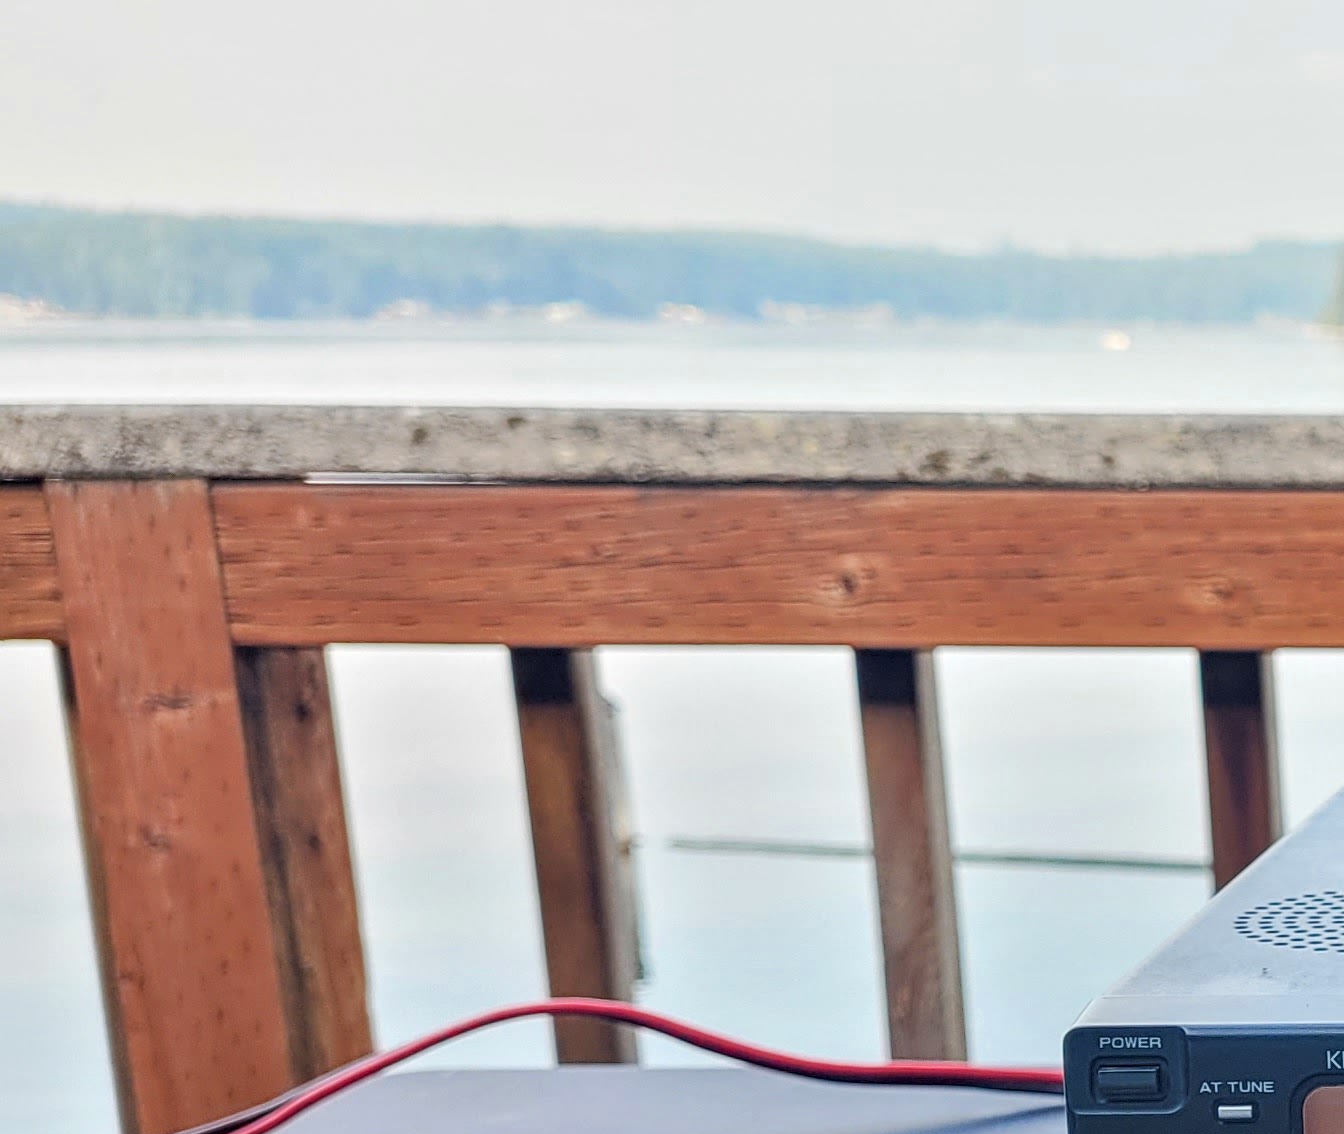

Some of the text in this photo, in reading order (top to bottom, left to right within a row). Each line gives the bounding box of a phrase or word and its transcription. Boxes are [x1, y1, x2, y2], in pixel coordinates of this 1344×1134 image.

[1099, 1036, 1163, 1049] POWER
[1199, 1081, 1275, 1094] AT TUNE
